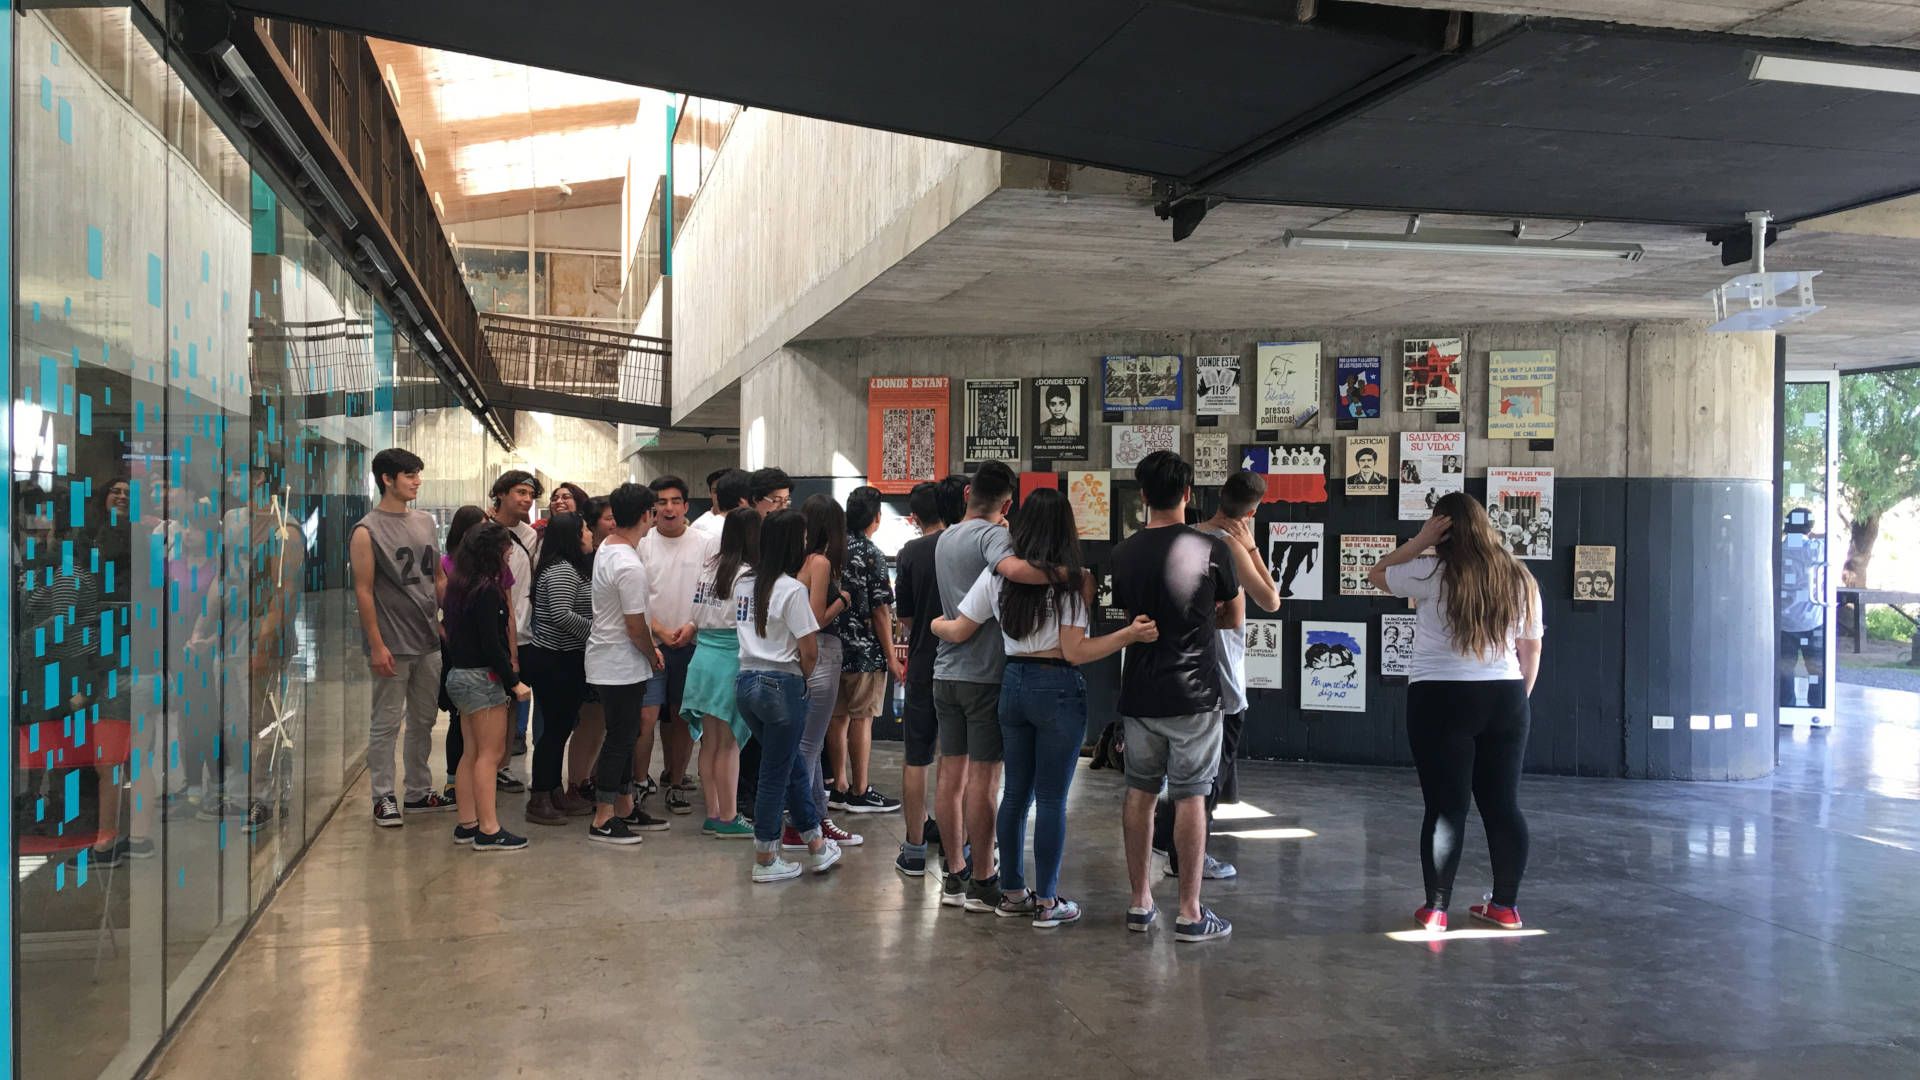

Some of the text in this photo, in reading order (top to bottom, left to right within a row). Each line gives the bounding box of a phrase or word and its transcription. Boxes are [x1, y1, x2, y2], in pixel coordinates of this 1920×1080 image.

[1265, 407, 1290, 416] presos
[1406, 433, 1460, 442] ¡SALVEMOS
[1411, 443, 1455, 451] SU VIDA!
[1271, 524, 1288, 535] NO
[396, 545, 434, 585] 24
